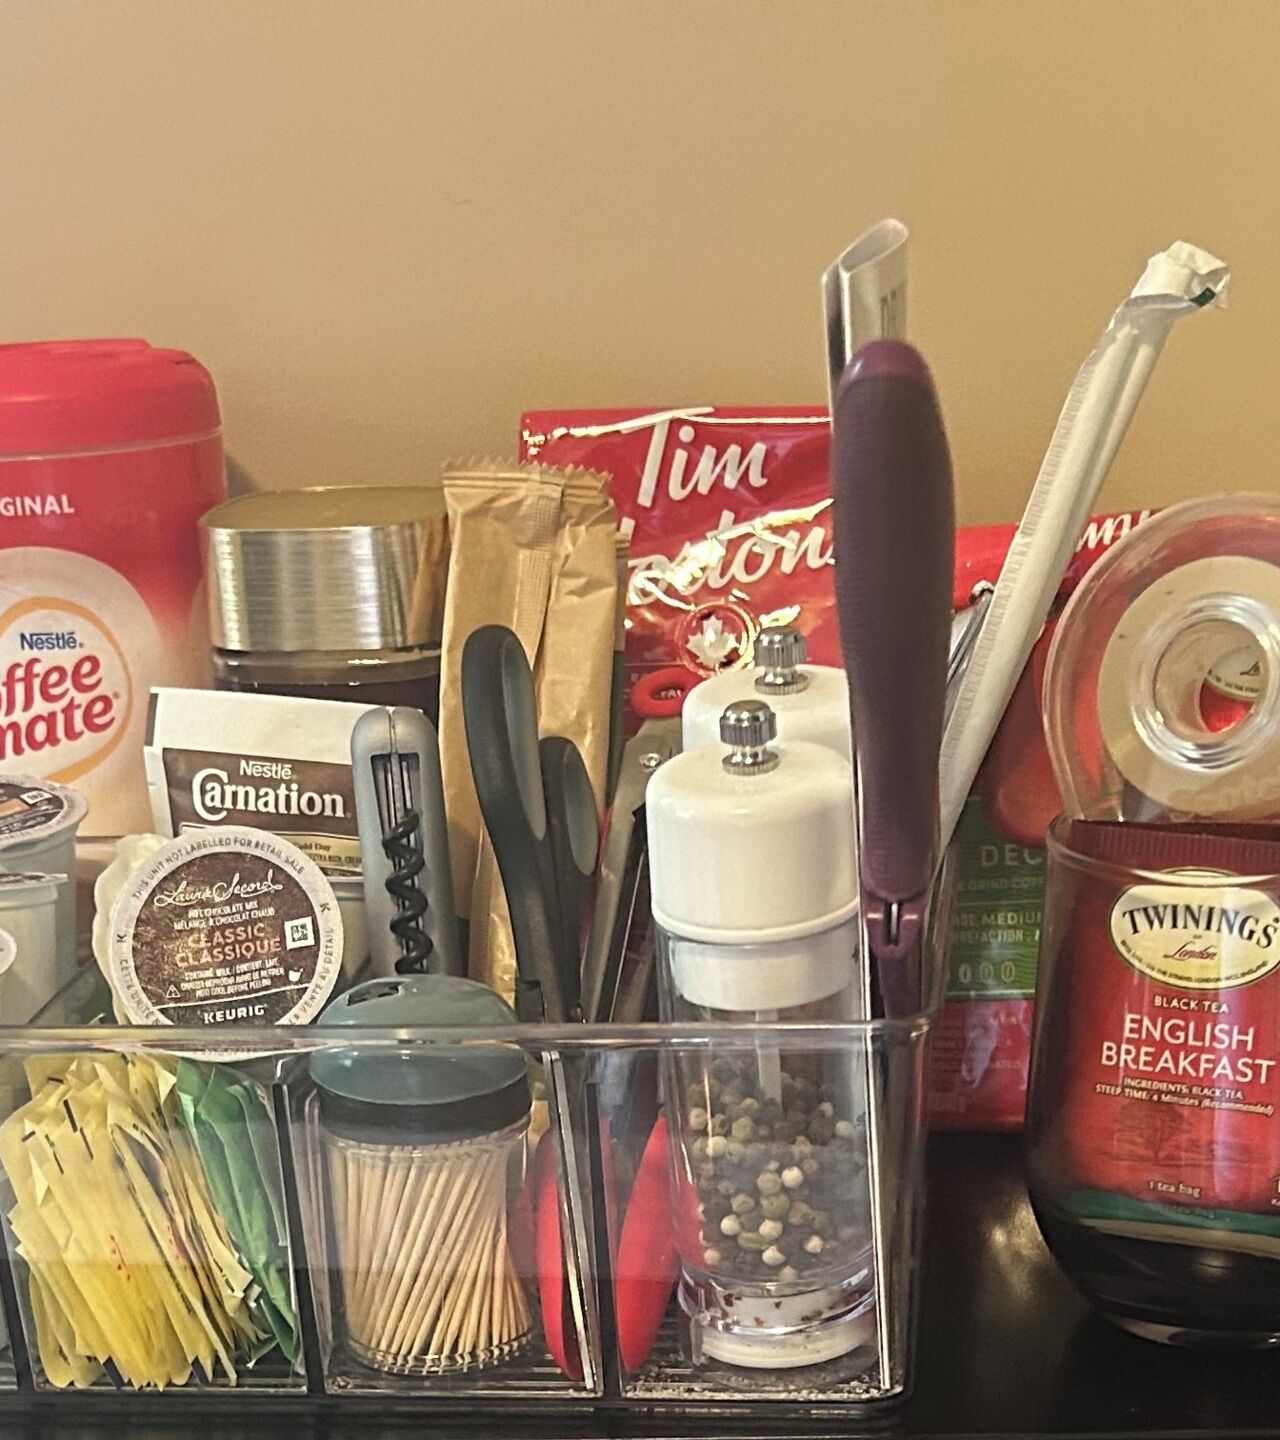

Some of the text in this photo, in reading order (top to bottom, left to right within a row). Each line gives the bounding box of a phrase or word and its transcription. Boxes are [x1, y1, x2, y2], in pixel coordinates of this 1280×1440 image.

[622, 407, 768, 507] Tim
[20, 630, 85, 651] Nestlé
[239, 759, 293, 780] Nestlé
[192, 767, 346, 821] Carnation
[165, 849, 184, 864] NOT
[185, 837, 231, 855] LABELLED
[233, 837, 253, 848] FOR
[187, 922, 265, 948] CLASSIC
[1122, 904, 1280, 949] TWININGS
[175, 936, 282, 967] CLASSIQUE
[1163, 940, 1218, 961] London
[203, 1004, 265, 1024] KEURIG
[1153, 995, 1229, 1015] BLACK TEA
[1123, 1013, 1255, 1051] ENGLISH
[1101, 1041, 1276, 1084] BREAKFAST
[1095, 1083, 1121, 1096] STEEP
[1191, 1086, 1221, 1097] BLACK
[1157, 1182, 1176, 1193] tea
[1178, 1183, 1201, 1198] bag
